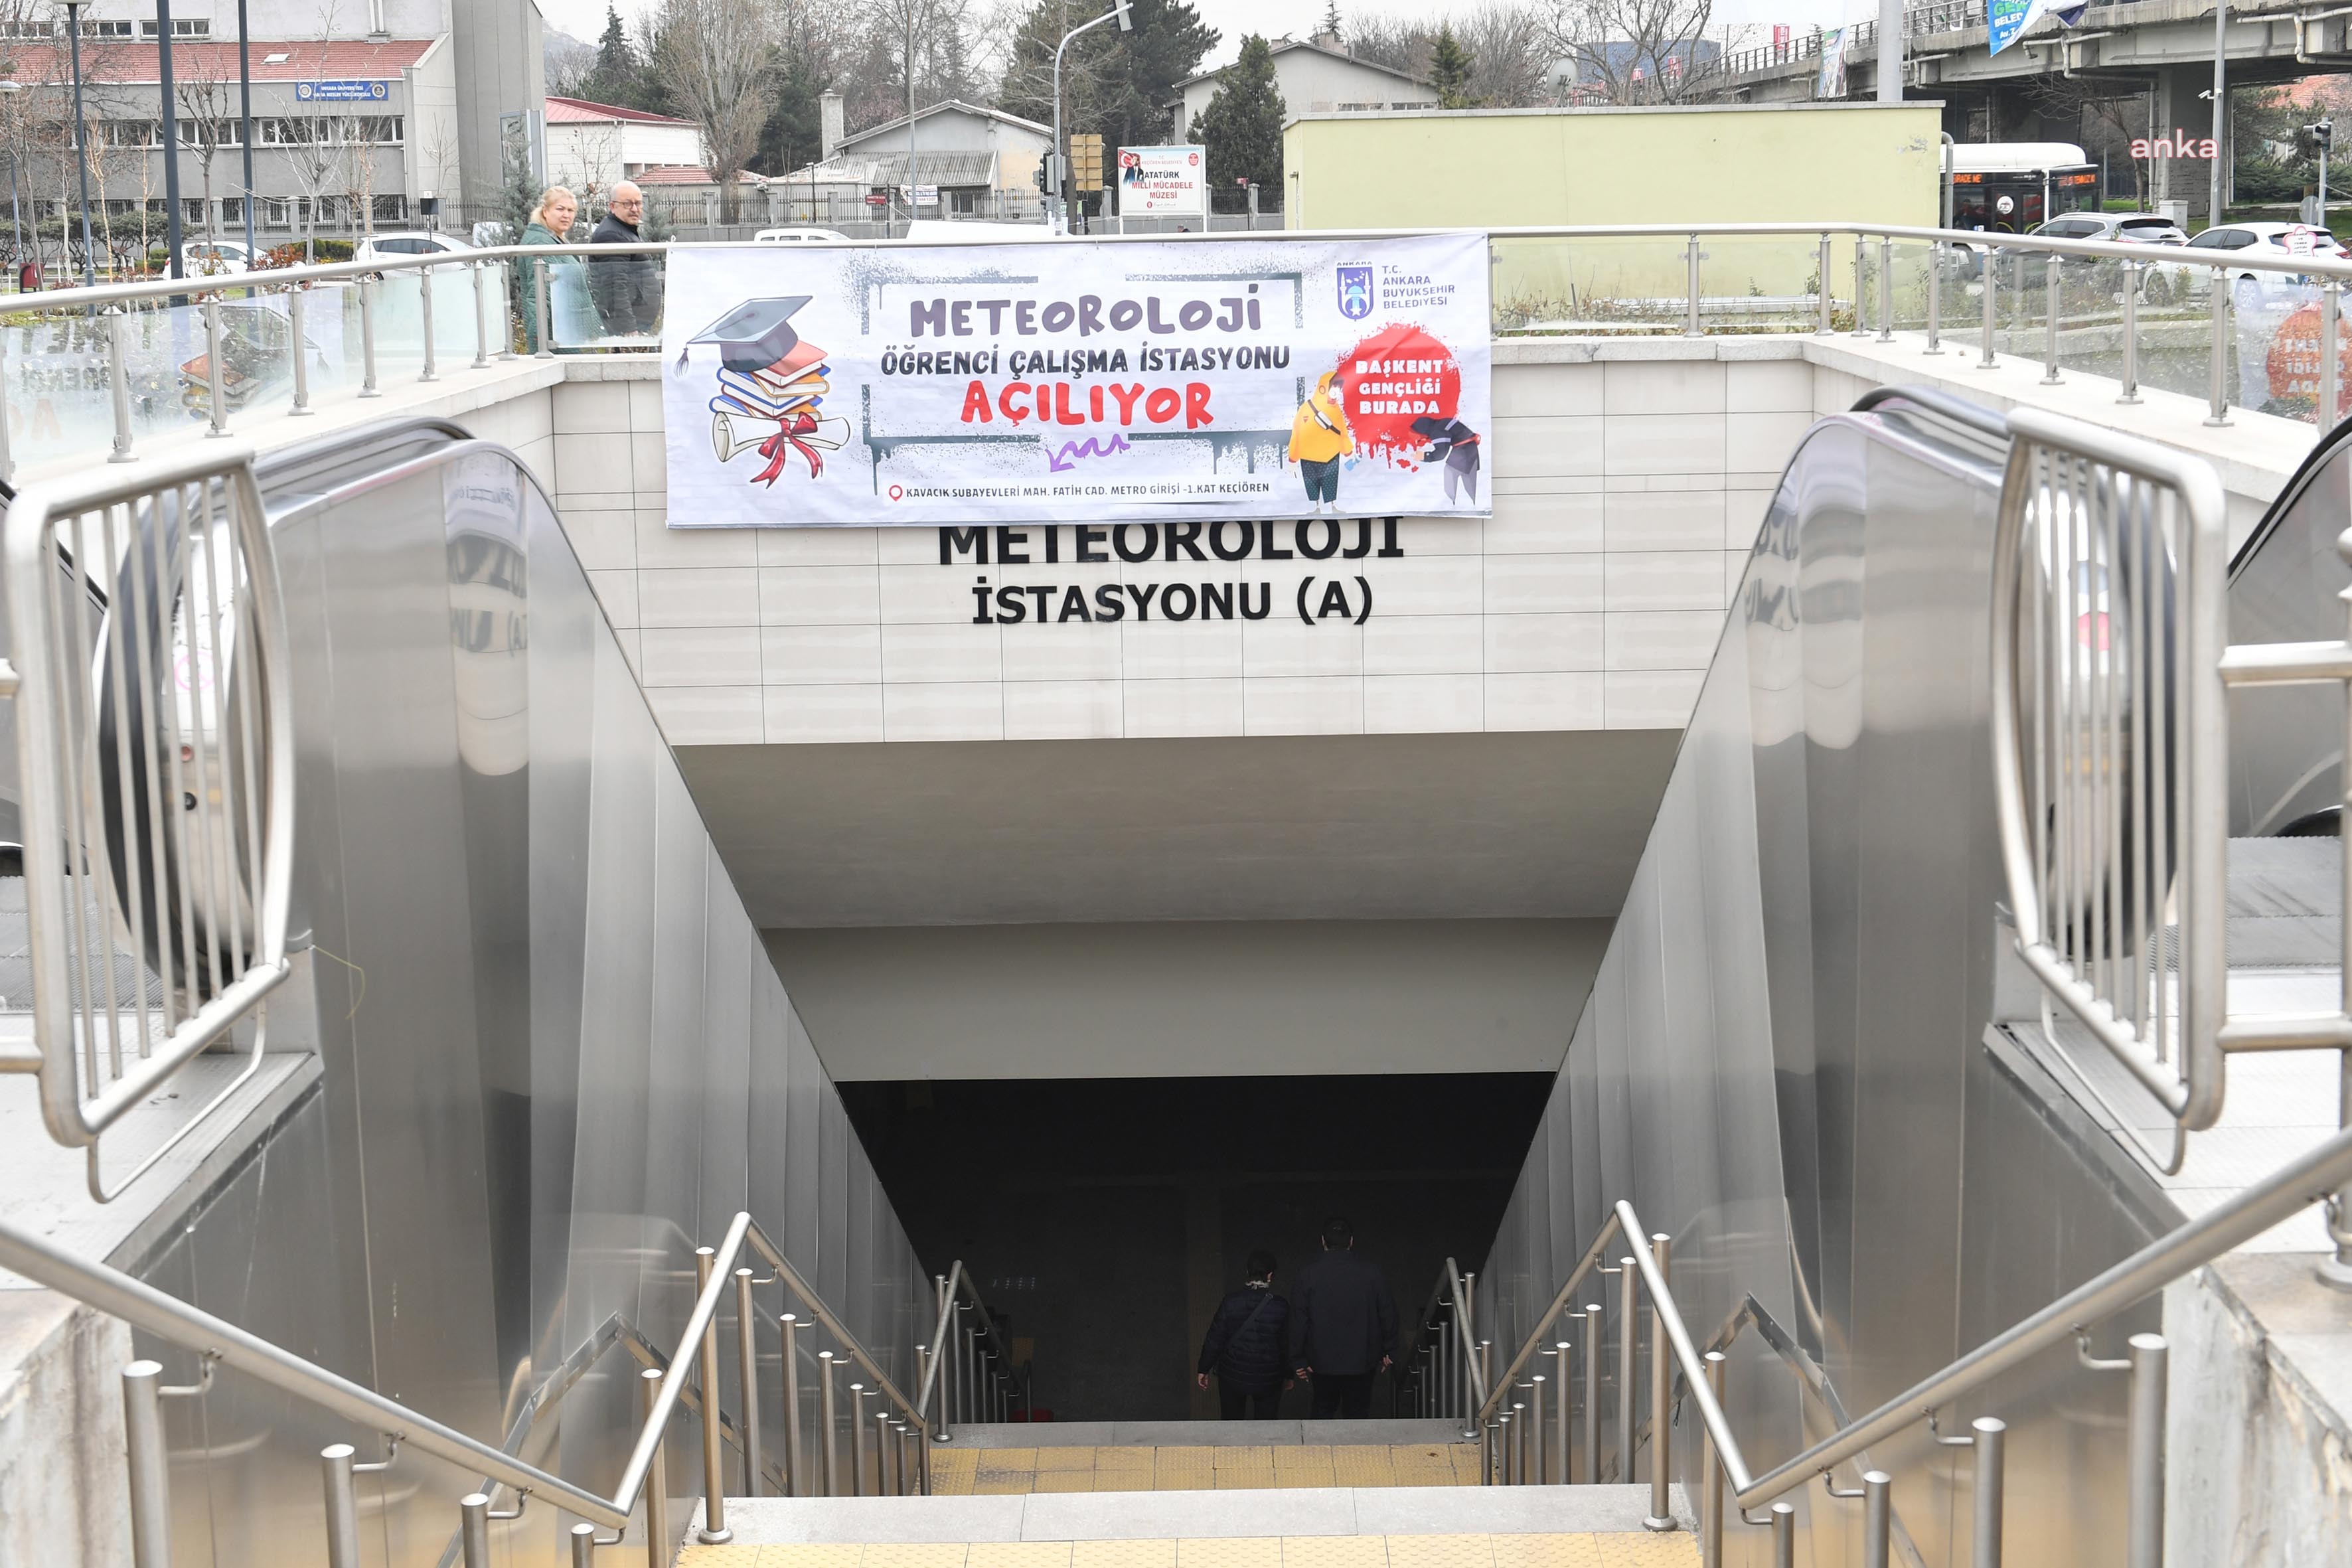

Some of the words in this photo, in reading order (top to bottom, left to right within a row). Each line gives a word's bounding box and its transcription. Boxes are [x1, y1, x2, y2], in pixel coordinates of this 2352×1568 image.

[1144, 170, 1180, 179] ATATÜRK
[1153, 180, 1194, 189] MÜCADELE
[1150, 190, 1178, 199] MÜZESİ
[1381, 265, 1402, 274] T.C.
[1383, 275, 1431, 285] ANKARA
[910, 283, 1261, 338] METEOROLOJİ
[881, 343, 998, 376] ÖĞRENCİ
[1009, 349, 1129, 380] ÇALIŞMA
[1140, 341, 1291, 372] İSTASYONU
[1355, 359, 1443, 378] BAŞKENT
[1359, 377, 1441, 398] GENÇLİĞİ
[961, 380, 1214, 430] AÇILIYOR
[1359, 400, 1440, 414] BURADA
[906, 488, 949, 498] KAVACIK
[952, 485, 1020, 497] SUBAYEVLERİ
[1023, 487, 1050, 497] MAH.
[1053, 485, 1082, 496] FATİH
[1085, 486, 1107, 495] CAD.
[1111, 485, 1147, 495] METRO
[1150, 483, 1180, 495] GİRİŞİ
[1219, 483, 1269, 495] KEÇİÖREN
[972, 576, 1271, 624] İSTASYONU
[1297, 576, 1373, 625] (A)
